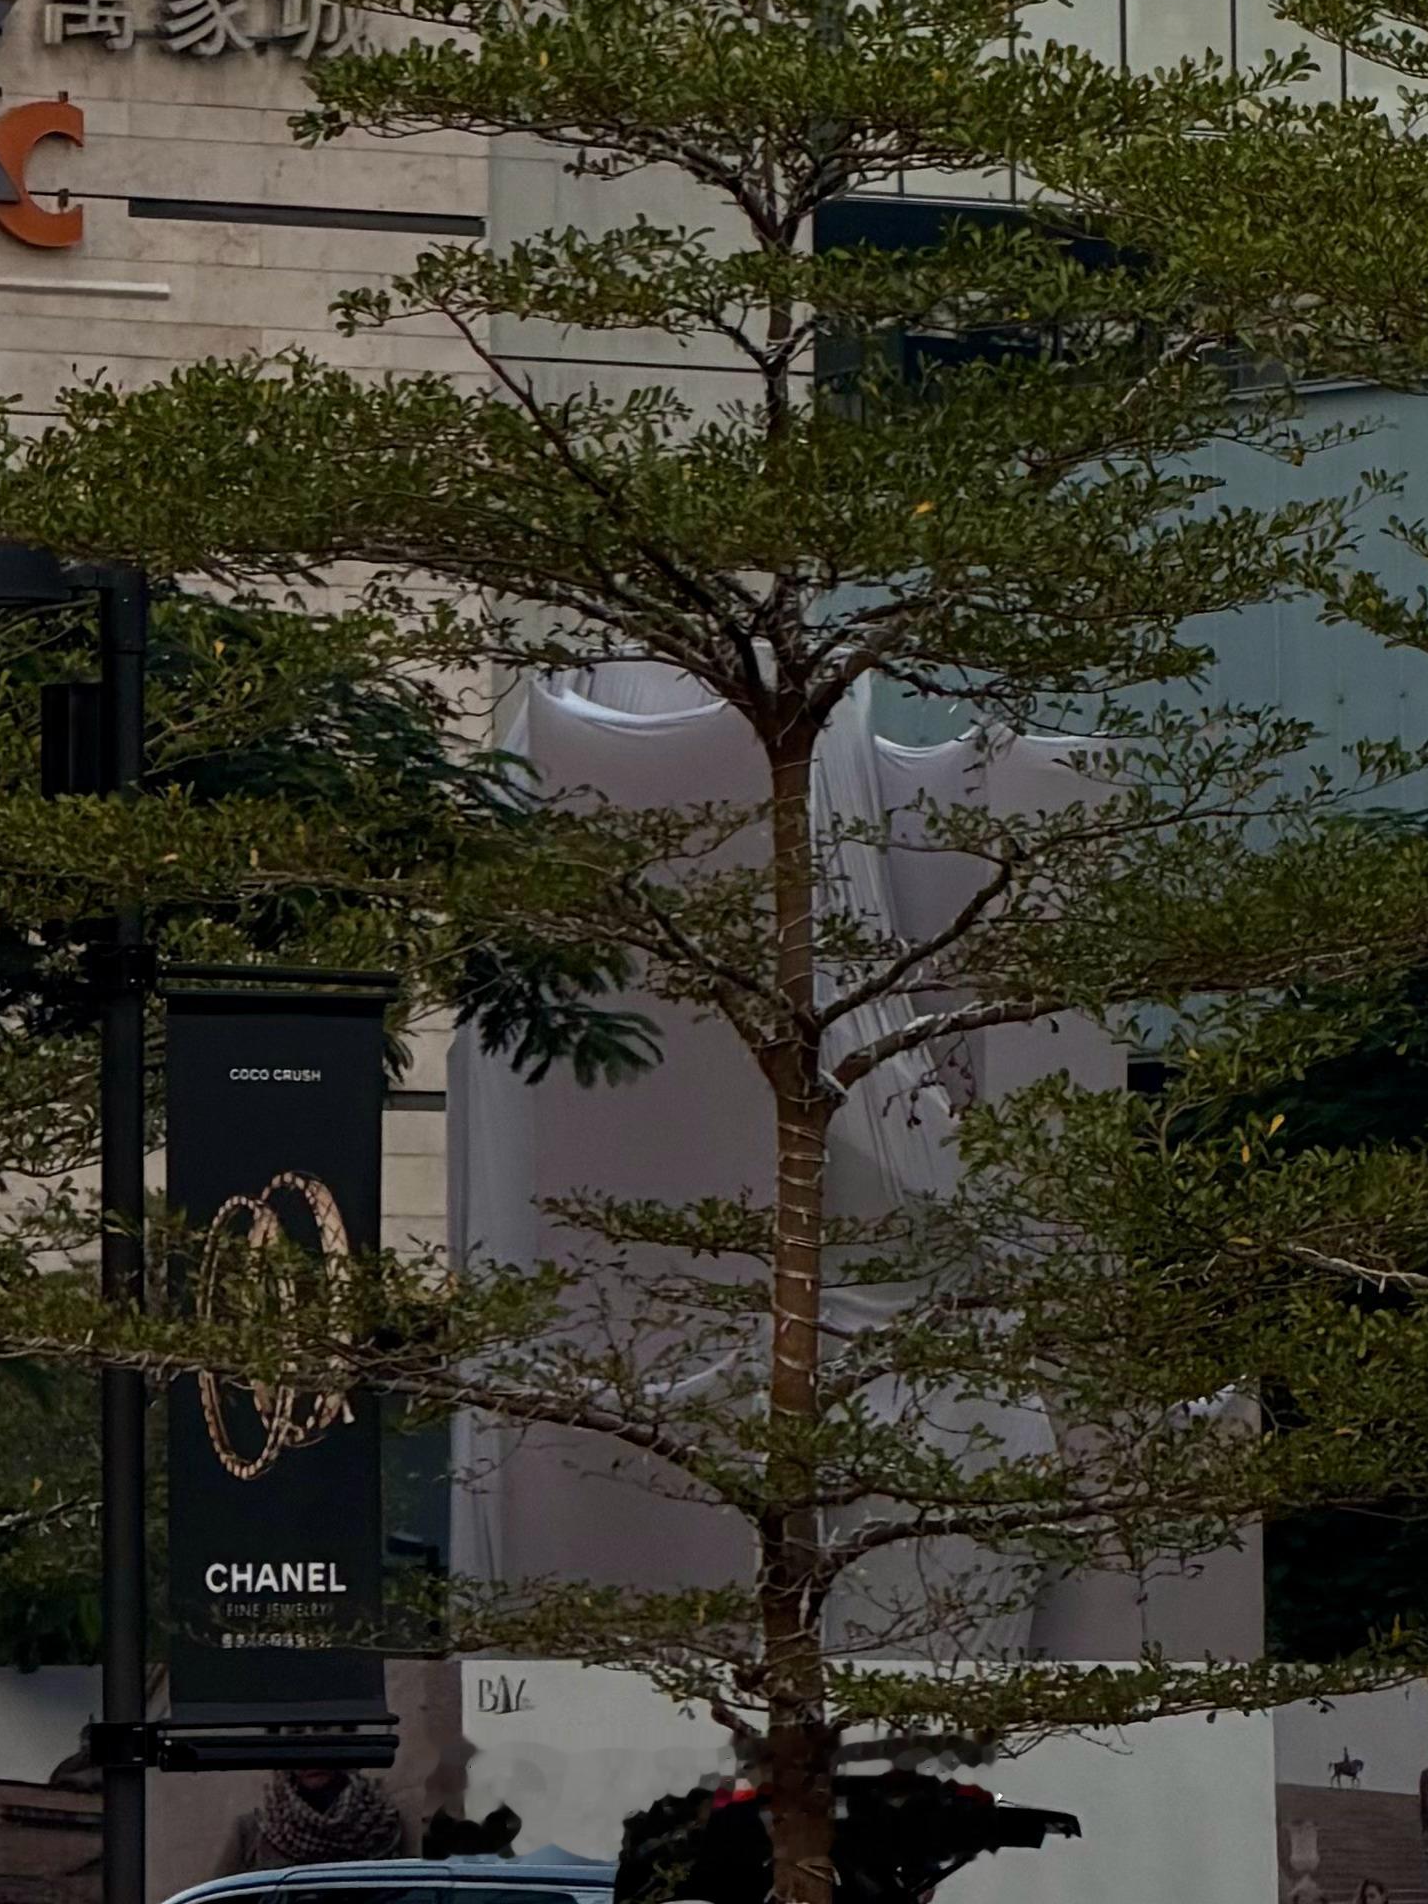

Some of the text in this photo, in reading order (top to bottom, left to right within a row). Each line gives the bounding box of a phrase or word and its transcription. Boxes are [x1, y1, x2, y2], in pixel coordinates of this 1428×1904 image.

[229, 1068, 321, 1081] COCO CRUSH
[205, 1562, 347, 1593] CHANEL
[226, 1603, 261, 1617] FINE
